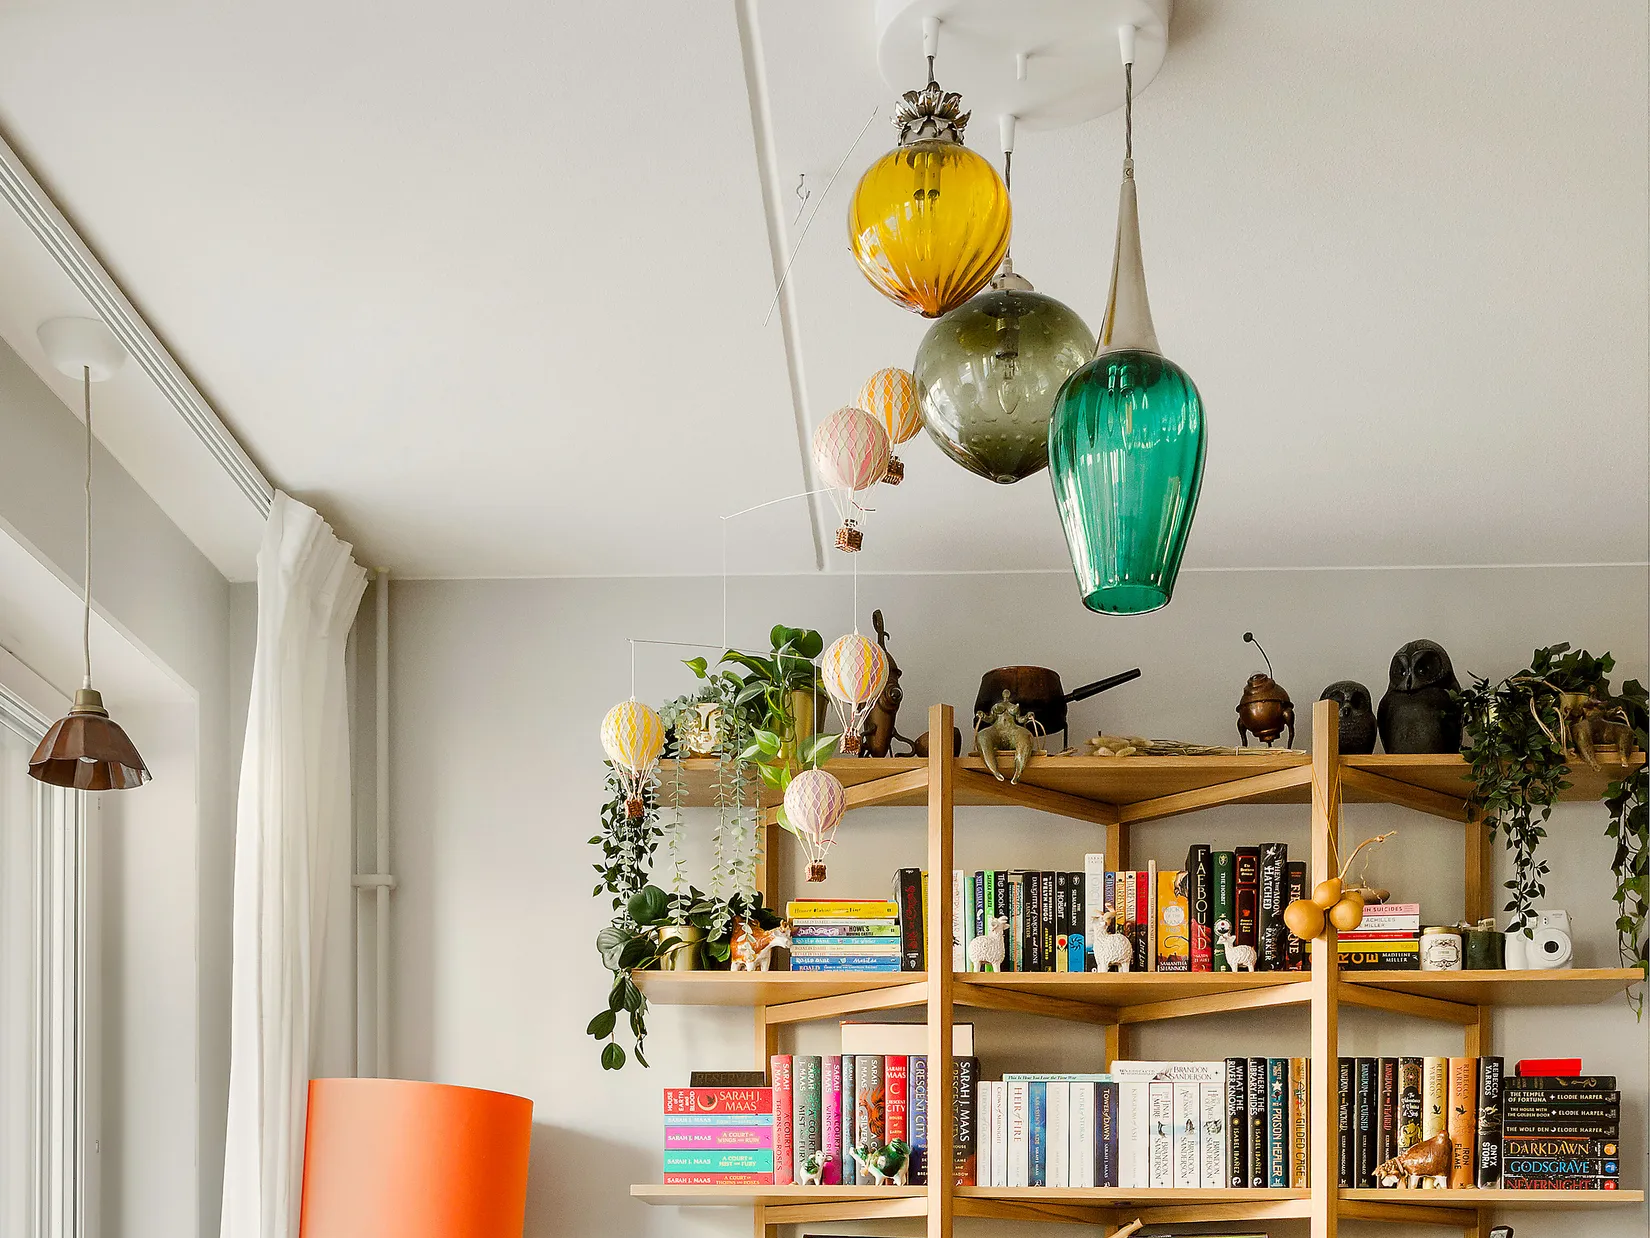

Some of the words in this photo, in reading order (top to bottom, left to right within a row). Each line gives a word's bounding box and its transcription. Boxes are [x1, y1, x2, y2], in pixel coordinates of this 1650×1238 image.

[1274, 859, 1282, 882] WHEN
[1031, 877, 1039, 908] DAUGHTER
[1196, 849, 1208, 951] FAEBOUND
[1263, 865, 1274, 910] HATCHED
[1271, 891, 1281, 917] MOON
[1031, 916, 1039, 936] SMOKE
[960, 1062, 970, 1099] SARAH
[1228, 1060, 1236, 1084] RIVER
[1236, 1066, 1244, 1092] WHAT
[1484, 1065, 1492, 1096] YARROS
[1491, 1062, 1499, 1099] REBECCA
[719, 1091, 754, 1101] SARAH
[755, 1091, 762, 1102] J.
[915, 1061, 926, 1113] CRESCENT
[1014, 1087, 1022, 1111] HEIR
[725, 1103, 757, 1111] MAAS
[1228, 1085, 1236, 1116] KNOWS
[1236, 1094, 1244, 1111] THE
[915, 1115, 926, 1139] CITY
[960, 1109, 970, 1142] MAAS
[1014, 1120, 1022, 1142] FIRE
[1272, 1108, 1282, 1140] PRISON
[1296, 1118, 1305, 1149] GILDED
[1272, 1142, 1282, 1176] HEALER
[1481, 1142, 1490, 1169] STORM
[1489, 1145, 1498, 1166] ONYX
[1510, 1141, 1589, 1156] DARKDAWN
[1296, 1152, 1305, 1176] CAGE
[1510, 1160, 1590, 1173] GODSGRAVE
[1506, 1179, 1591, 1190] NEVERNIGHT
